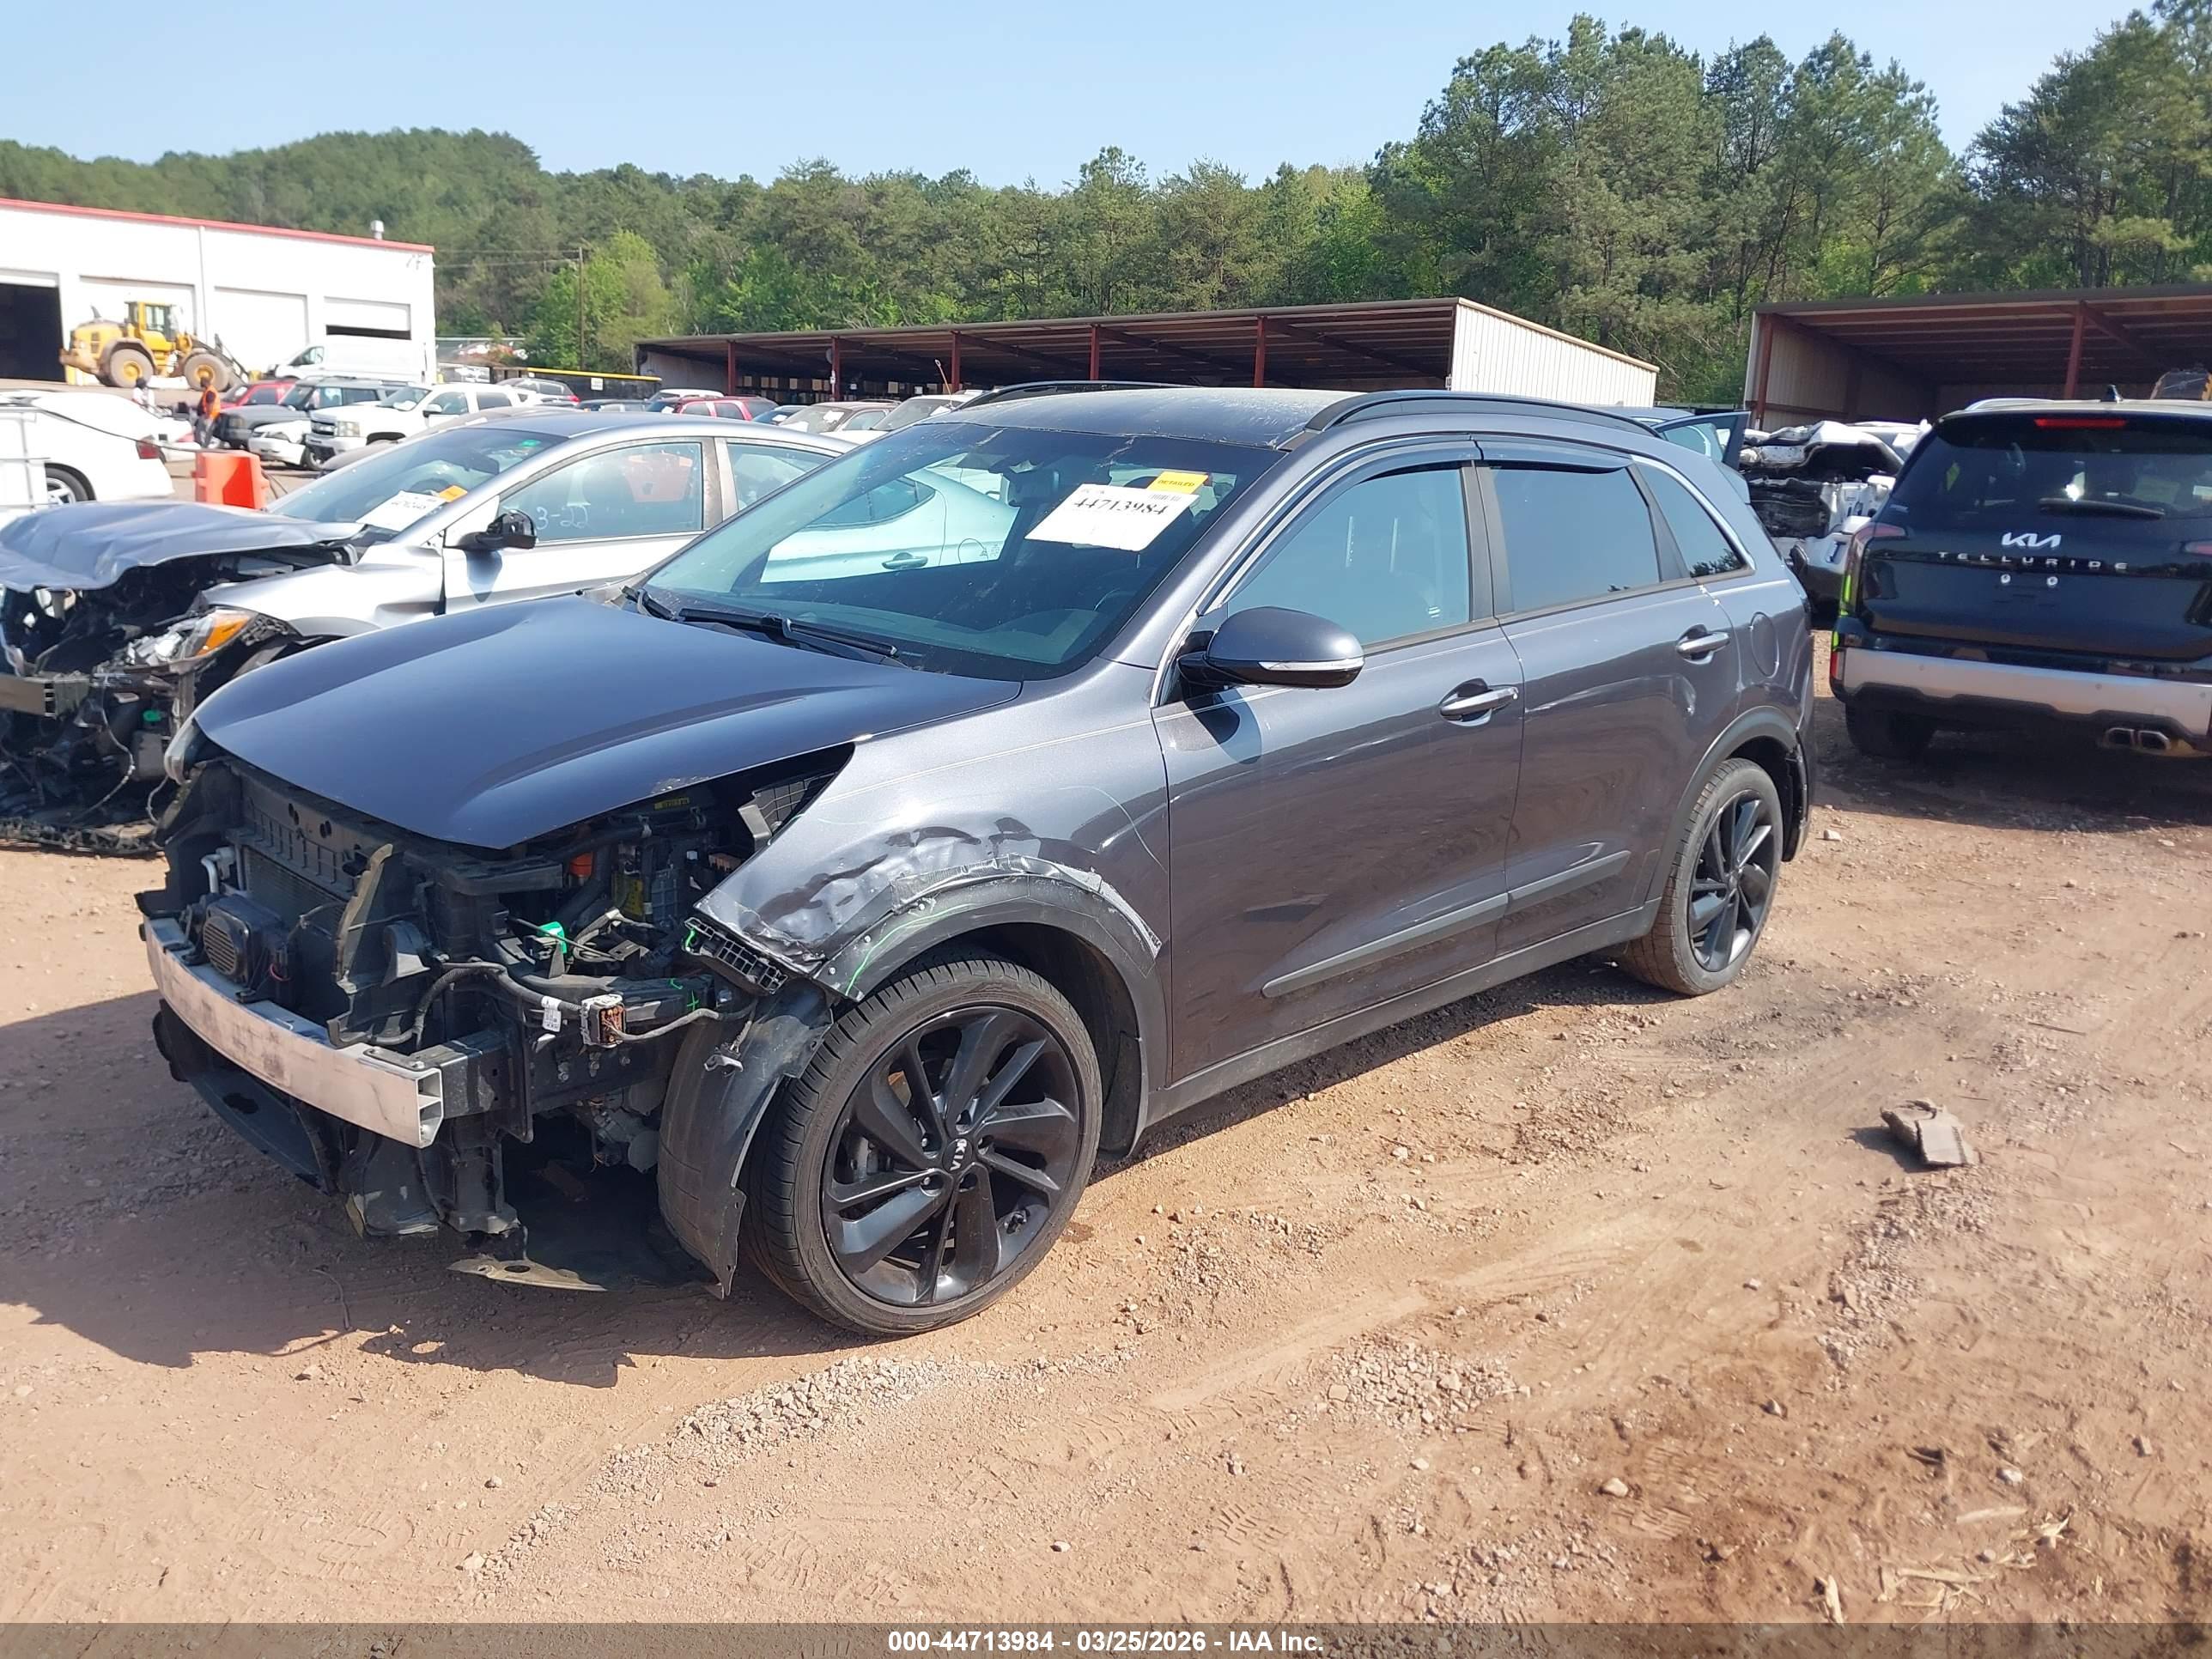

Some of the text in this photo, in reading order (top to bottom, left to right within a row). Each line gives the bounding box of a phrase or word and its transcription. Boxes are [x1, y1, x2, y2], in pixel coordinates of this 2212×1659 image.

[1073, 497, 1169, 515] 44713984
[2001, 532, 2062, 549] KIA
[1938, 551, 2130, 570] TELLURIDE
[949, 1138, 968, 1171] KIA
